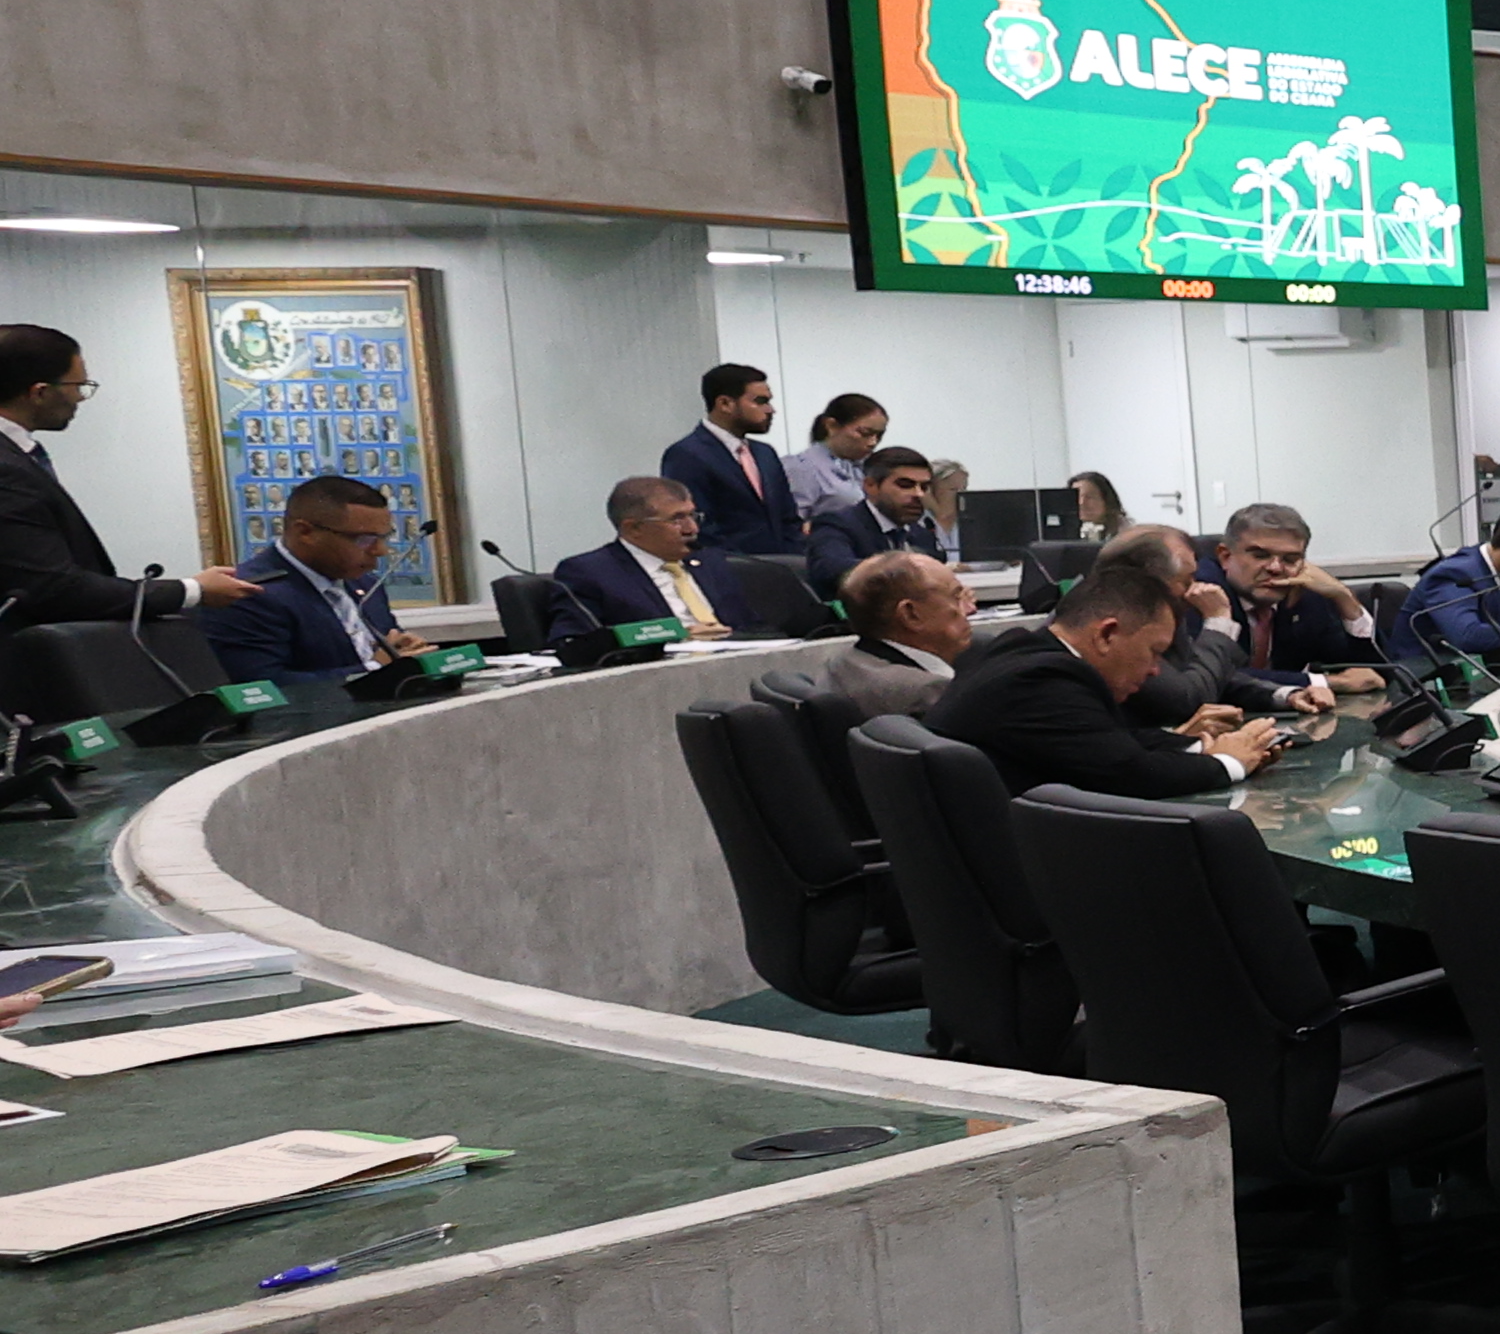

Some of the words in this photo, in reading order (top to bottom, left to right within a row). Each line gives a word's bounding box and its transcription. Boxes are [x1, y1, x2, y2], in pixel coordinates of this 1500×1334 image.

[1069, 29, 1264, 101] ALECE
[1015, 273, 1092, 295] 12:38:46
[1163, 279, 1214, 298] 00:00
[1286, 284, 1337, 303] 00:00
